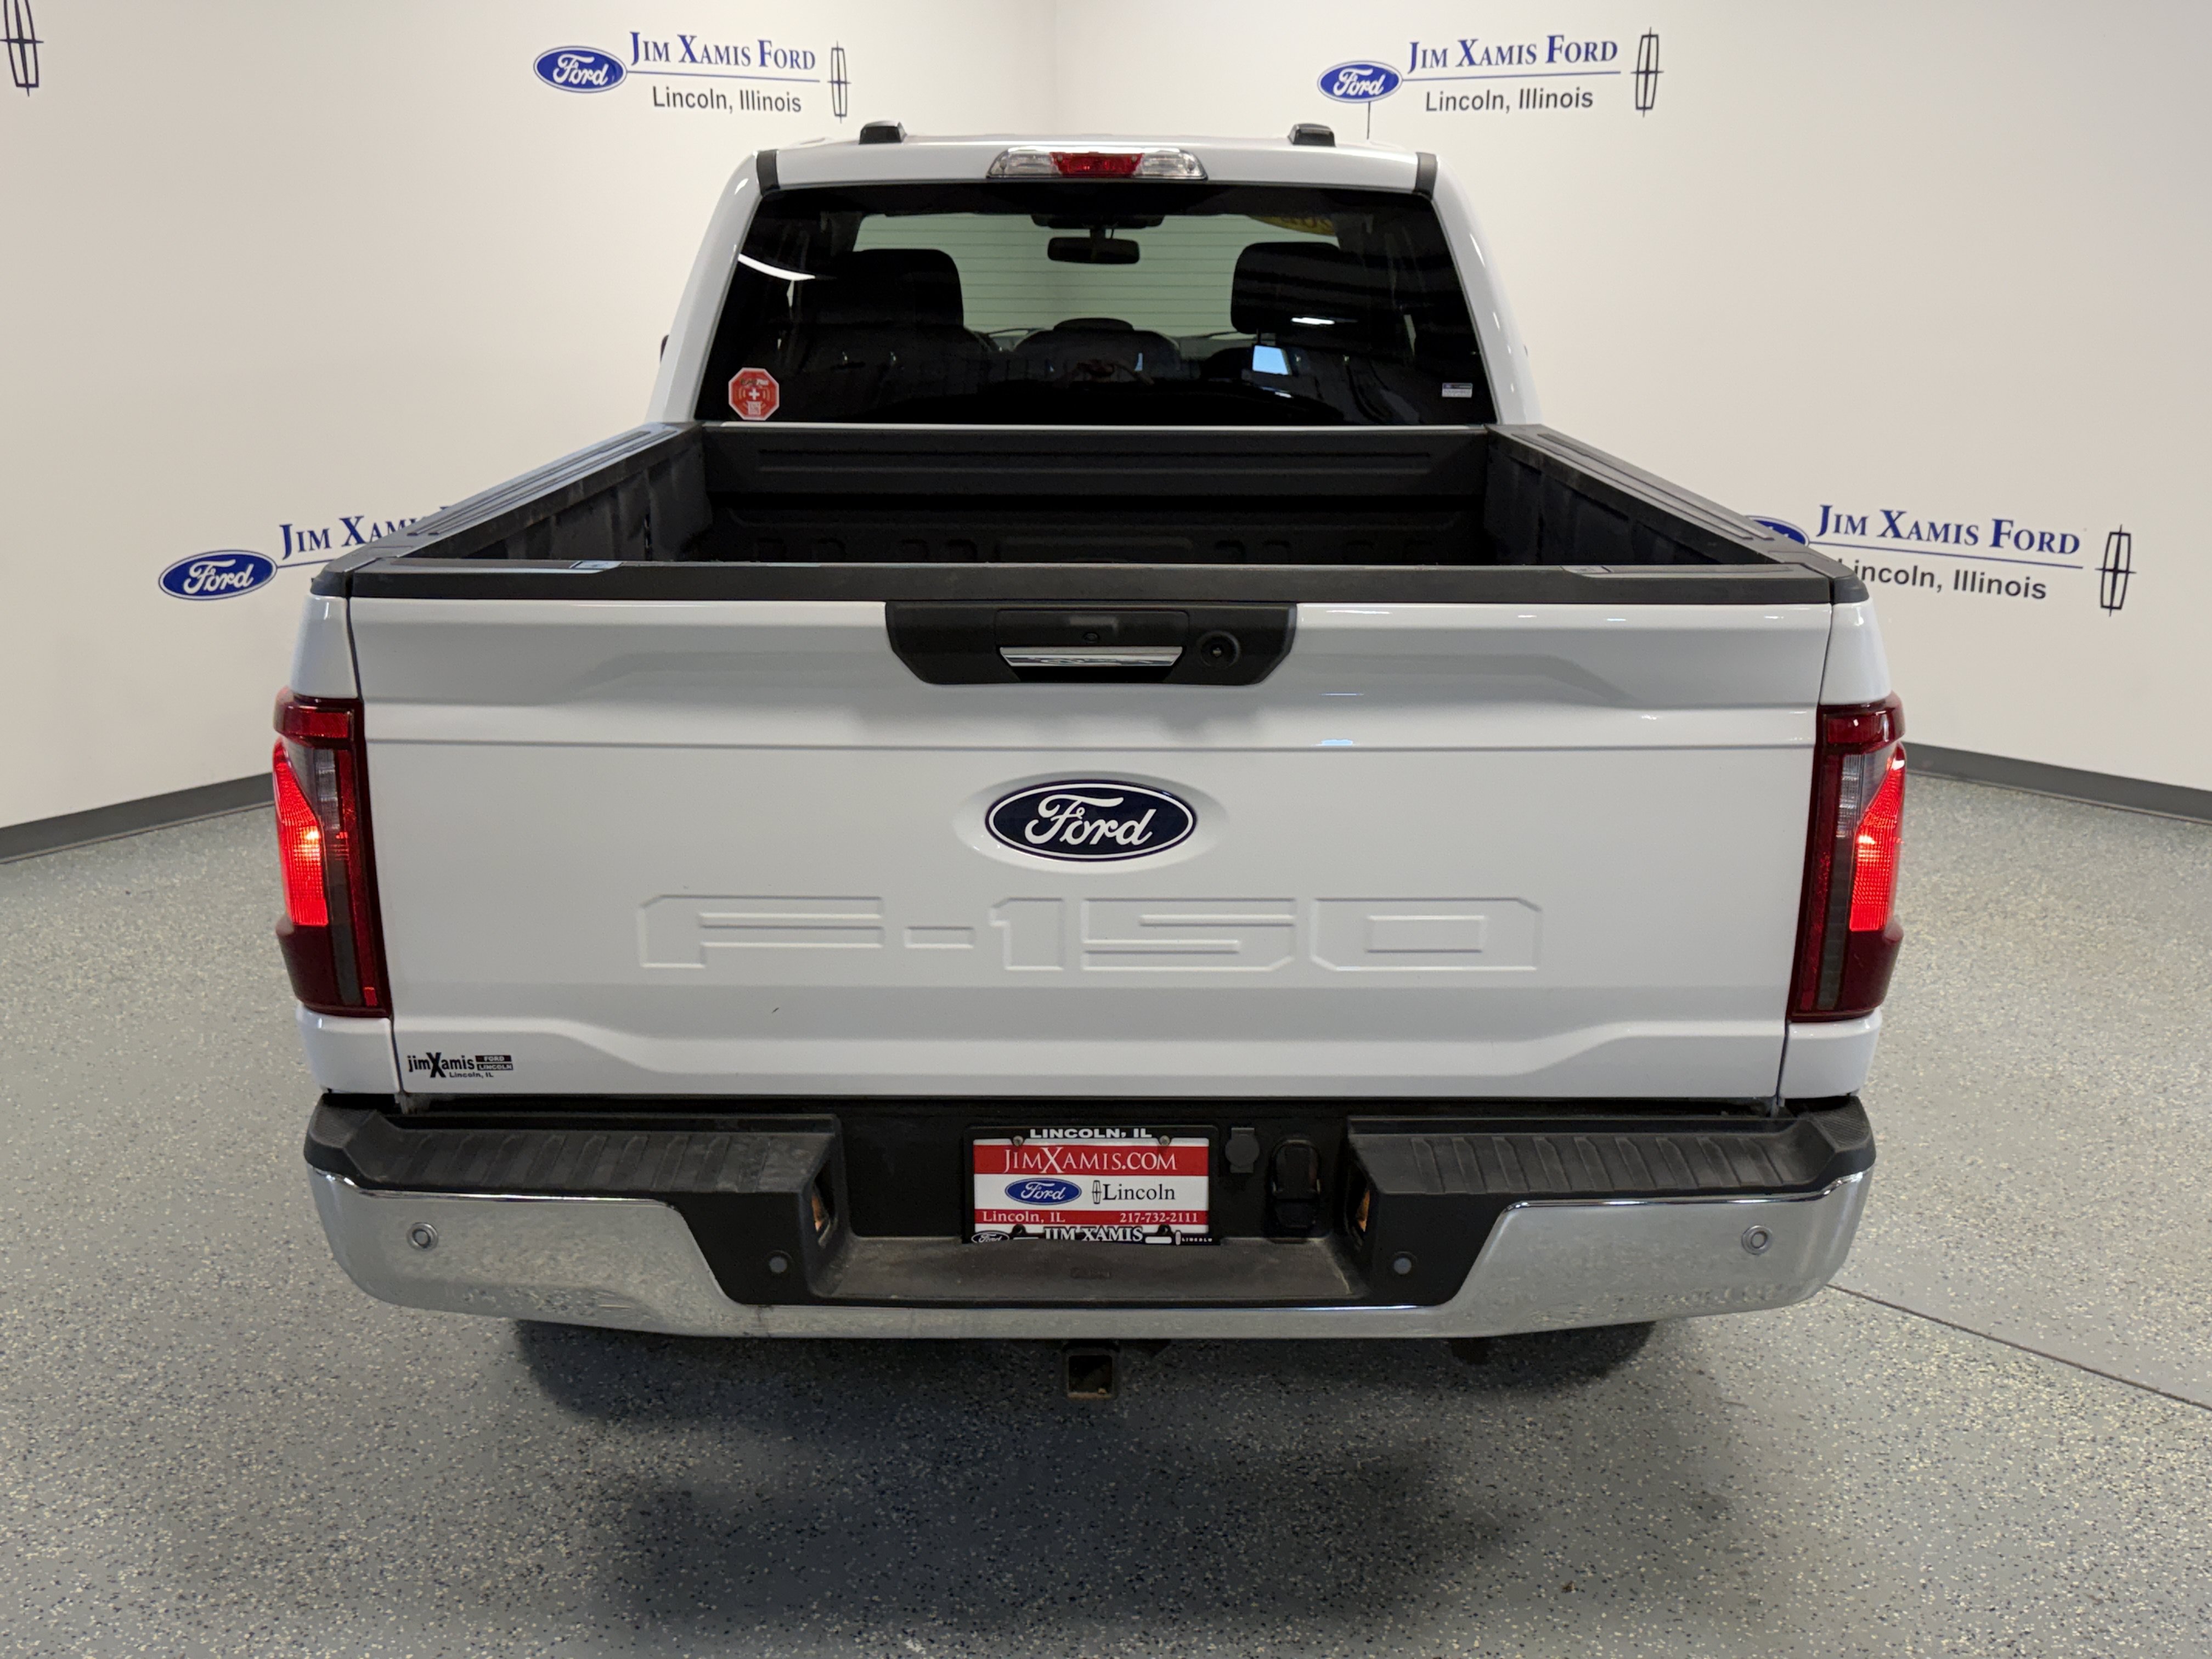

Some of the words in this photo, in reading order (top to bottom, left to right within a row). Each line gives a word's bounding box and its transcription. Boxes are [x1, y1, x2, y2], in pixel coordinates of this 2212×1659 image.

[630, 32, 670, 66] JIM
[678, 35, 751, 67] XAMIS
[758, 40, 816, 70] FORD
[1407, 42, 1448, 74] JIM
[1455, 39, 1537, 67] XAMIS
[1546, 35, 1618, 64] FORD
[552, 54, 608, 86] Ford
[1333, 67, 1384, 96] Ford
[653, 86, 733, 114] Lincoln,
[740, 90, 802, 112] Illinois
[1426, 89, 1510, 114] Lincoln,
[1519, 87, 1593, 110] Illinois
[280, 523, 331, 560] JIM
[1816, 505, 1869, 537] JIM
[1875, 510, 1979, 546] XAMIS
[1989, 518, 2080, 555] FORD
[183, 559, 254, 595] Ford
[1839, 558, 1943, 592] incoln,
[1953, 569, 2047, 600] Illinois
[1024, 793, 1157, 845] Ford
[637, 895, 1542, 972] F-150
[1029, 1128, 1127, 1139] LINCOLN,
[1133, 1128, 1153, 1139] IL
[1020, 1181, 1066, 1200] Ford
[1102, 1183, 1176, 1200] Lincoln
[983, 1211, 1045, 1223] Lincoln,
[1049, 1211, 1065, 1222] IL
[1119, 1212, 1198, 1223] 217-732-2111
[1081, 1227, 1144, 1242] XAMIS
